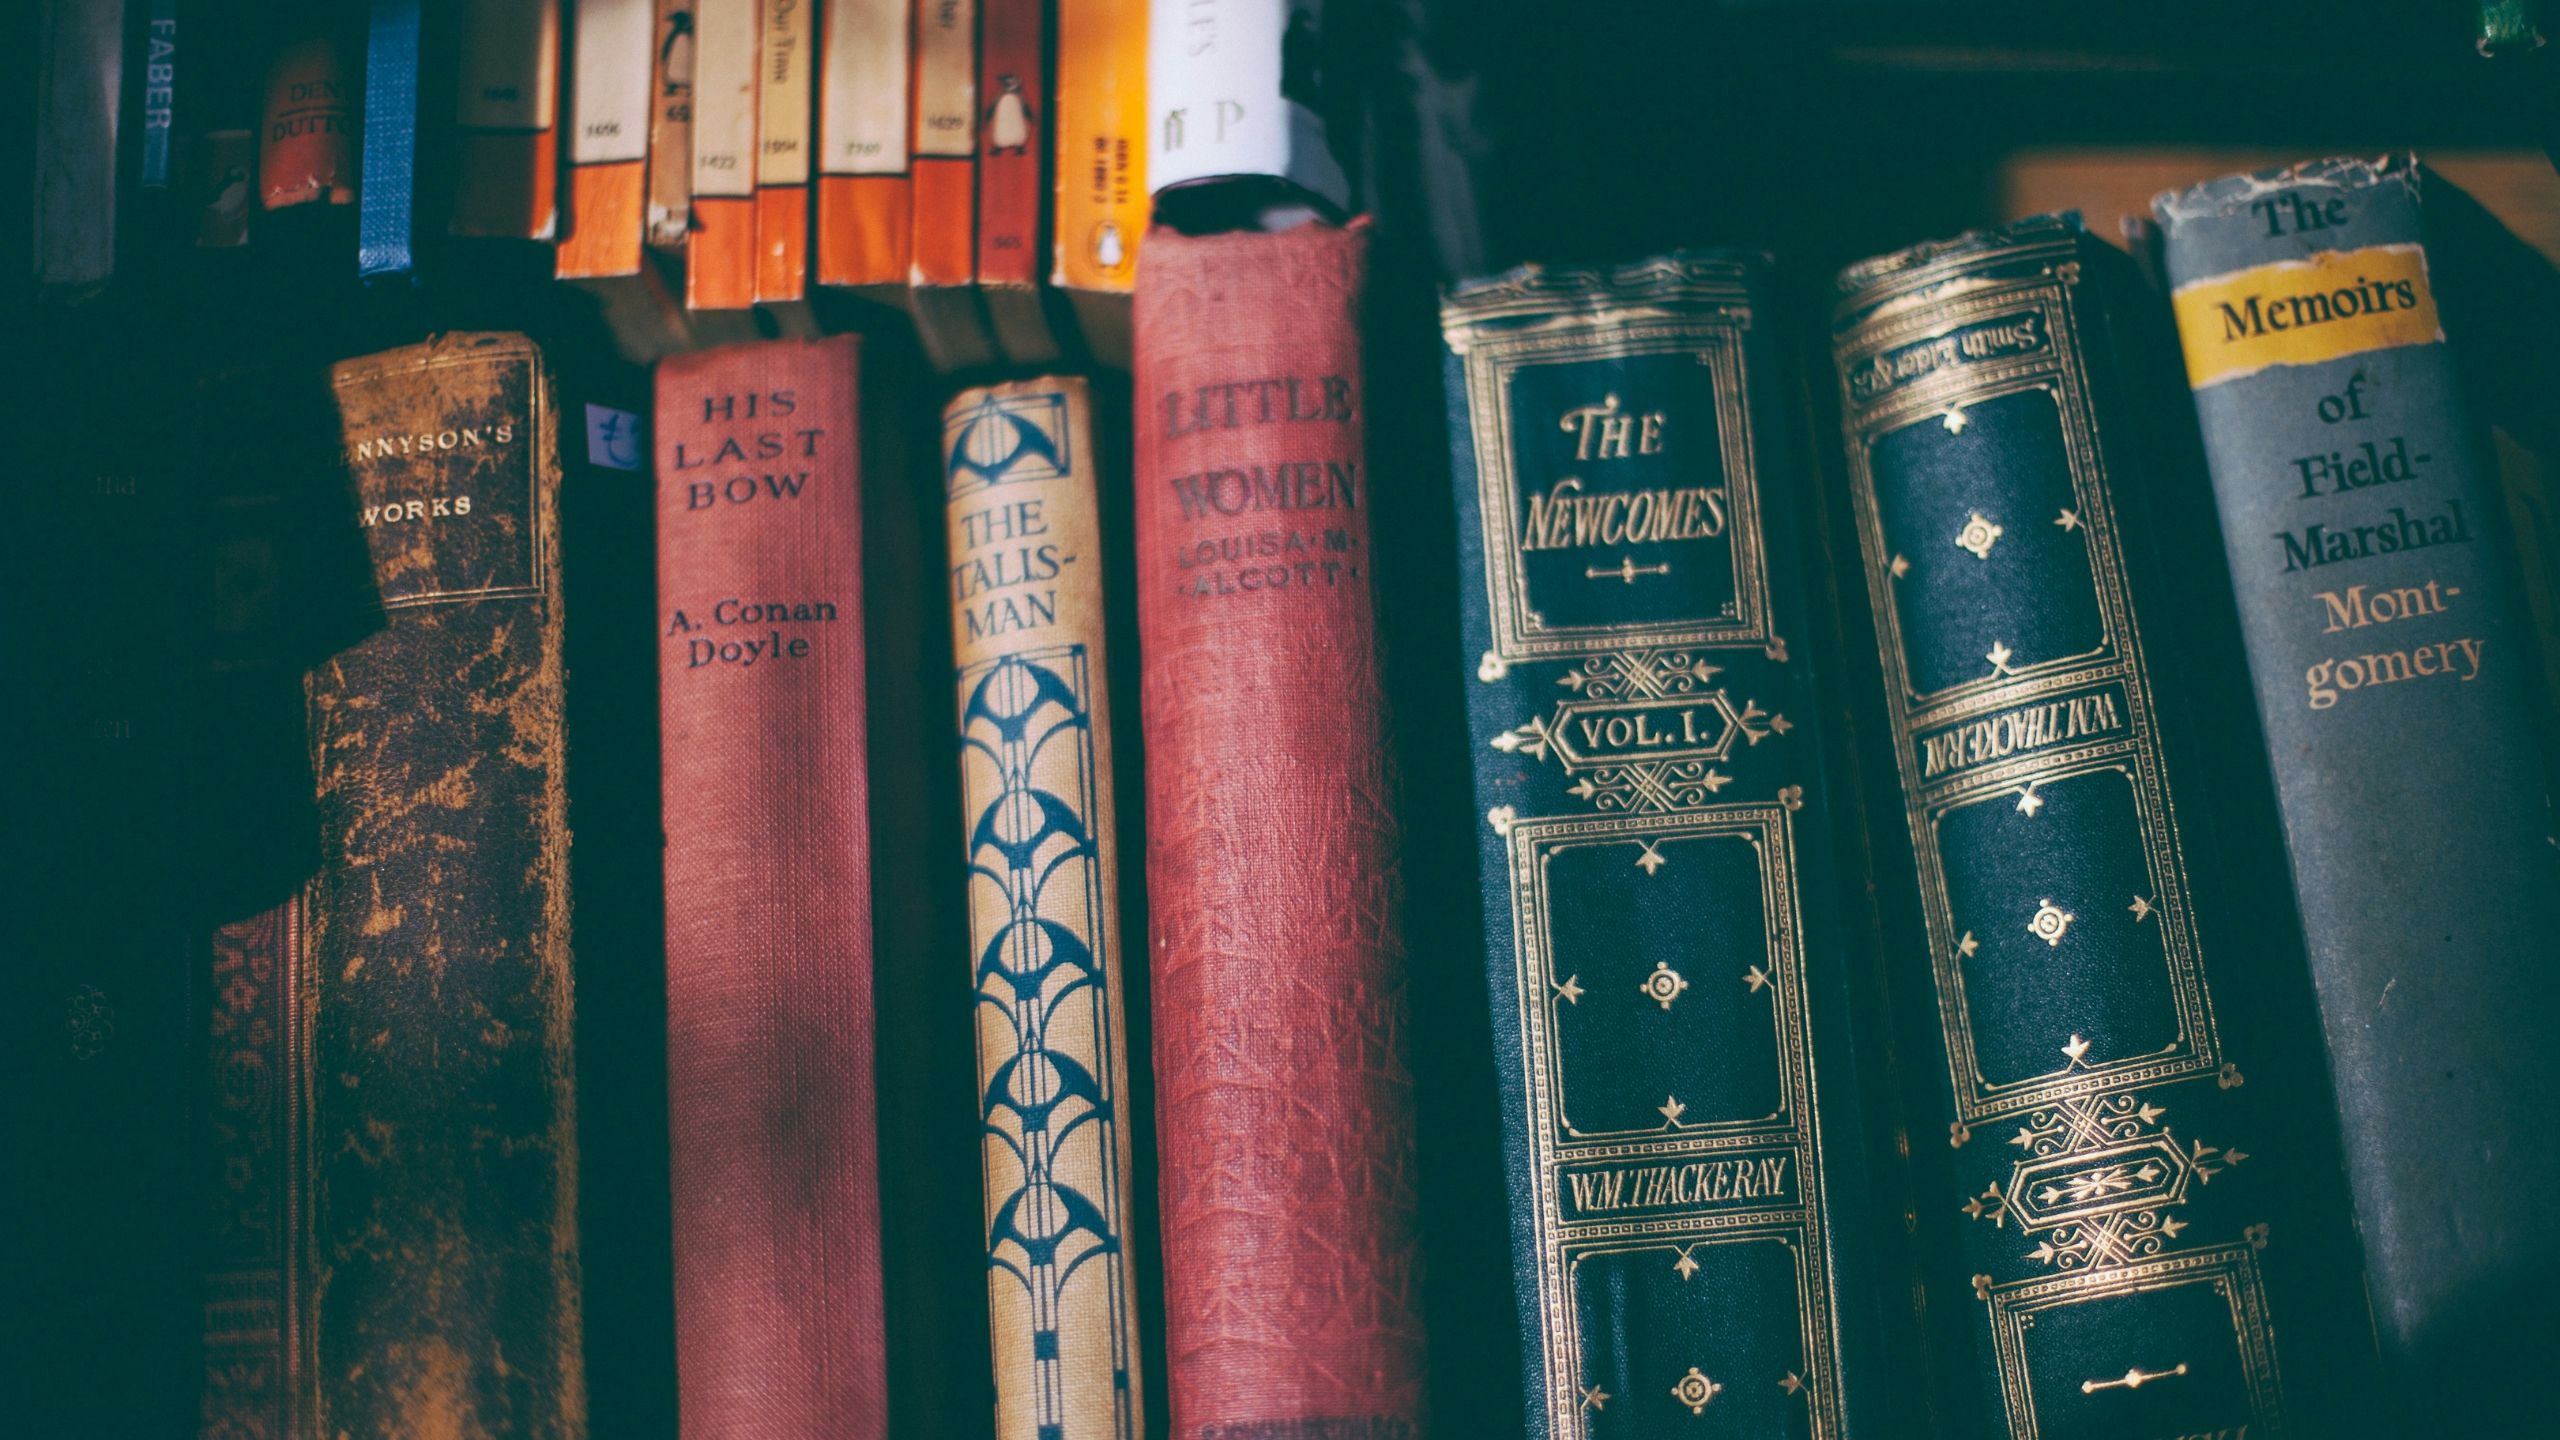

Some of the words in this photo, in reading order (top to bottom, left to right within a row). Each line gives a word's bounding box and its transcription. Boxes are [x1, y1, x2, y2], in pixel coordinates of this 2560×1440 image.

[146, 18, 176, 129] FABER
[2252, 193, 2349, 239] The
[2214, 275, 2418, 342] Memoirs
[1961, 317, 2039, 359] Smith
[703, 390, 797, 424] HIS
[1165, 374, 1353, 439] LITTLE
[2317, 373, 2371, 425] of
[674, 428, 826, 471] LAST
[2290, 437, 2433, 500] Field-
[358, 495, 472, 528] WORKS
[686, 471, 810, 511] BOW
[1171, 462, 1357, 522] WOMEN
[1520, 476, 1726, 552] NEWCOMES
[960, 499, 1049, 550] THE
[2272, 499, 2475, 574] Marshal
[951, 543, 1077, 602] TALIS-
[667, 608, 704, 637] A.
[713, 597, 838, 627] Conan
[964, 589, 1057, 645] MAN
[2312, 579, 2462, 634] Mont-
[688, 630, 811, 669] Doyle
[2305, 637, 2485, 710] gomery
[1578, 714, 1676, 749] VOL.
